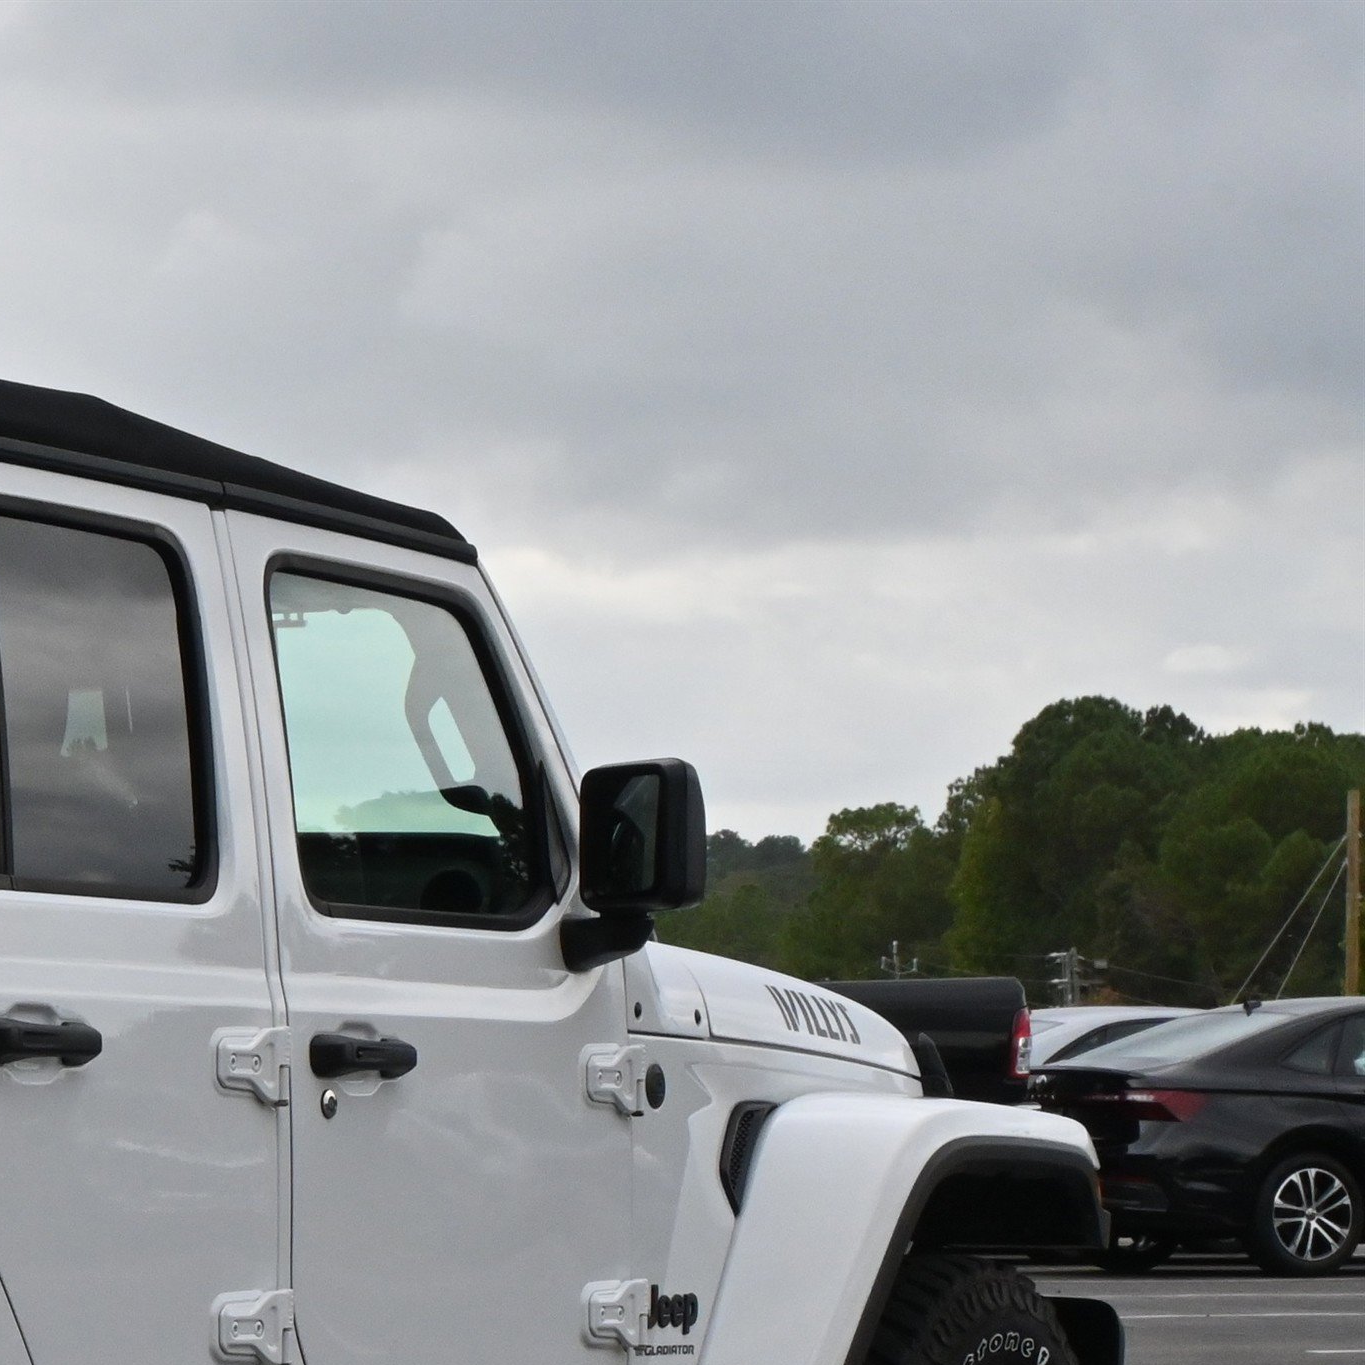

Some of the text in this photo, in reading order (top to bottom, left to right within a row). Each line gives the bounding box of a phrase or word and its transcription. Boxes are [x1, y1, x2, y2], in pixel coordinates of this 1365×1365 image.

[764, 984, 861, 1045] WILLYS
[647, 1284, 699, 1335] Jeep
[644, 1344, 695, 1356] GLADIATOR
